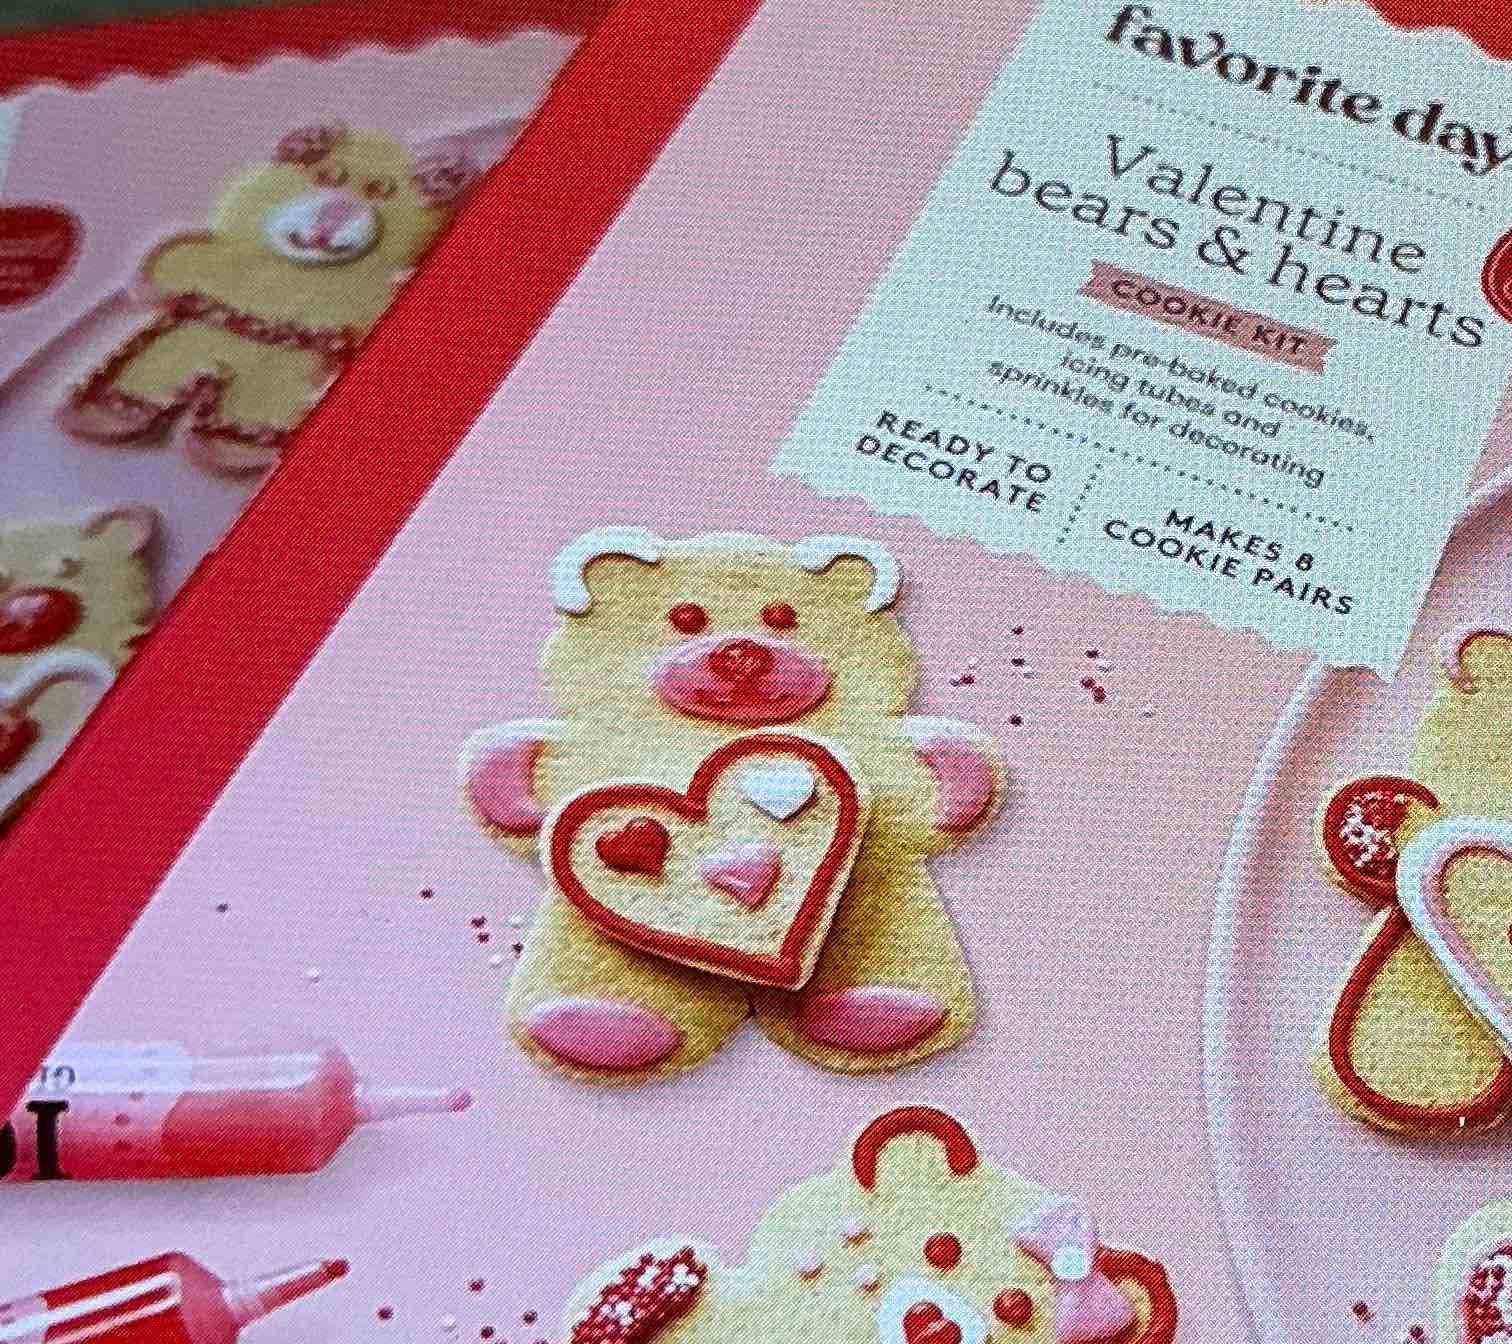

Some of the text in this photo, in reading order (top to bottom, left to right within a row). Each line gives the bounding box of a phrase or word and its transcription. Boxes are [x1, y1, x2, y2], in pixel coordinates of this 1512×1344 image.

[1106, 4, 1381, 124] favorite
[990, 150, 1485, 348] bears & hearts
[1106, 134, 1427, 273] Valentine
[1111, 279, 1308, 354] COOKIE KIT
[986, 295, 1374, 443] Includes pre-baked cookies,
[1060, 352, 1281, 438] icing tubes and
[855, 434, 1047, 513] DECORATE
[876, 410, 1052, 483] READY TO
[987, 360, 1325, 489] sprinkles for decorating
[1104, 518, 1354, 616] COOKIE PAIRS
[1164, 509, 1315, 572] MAKES 8
